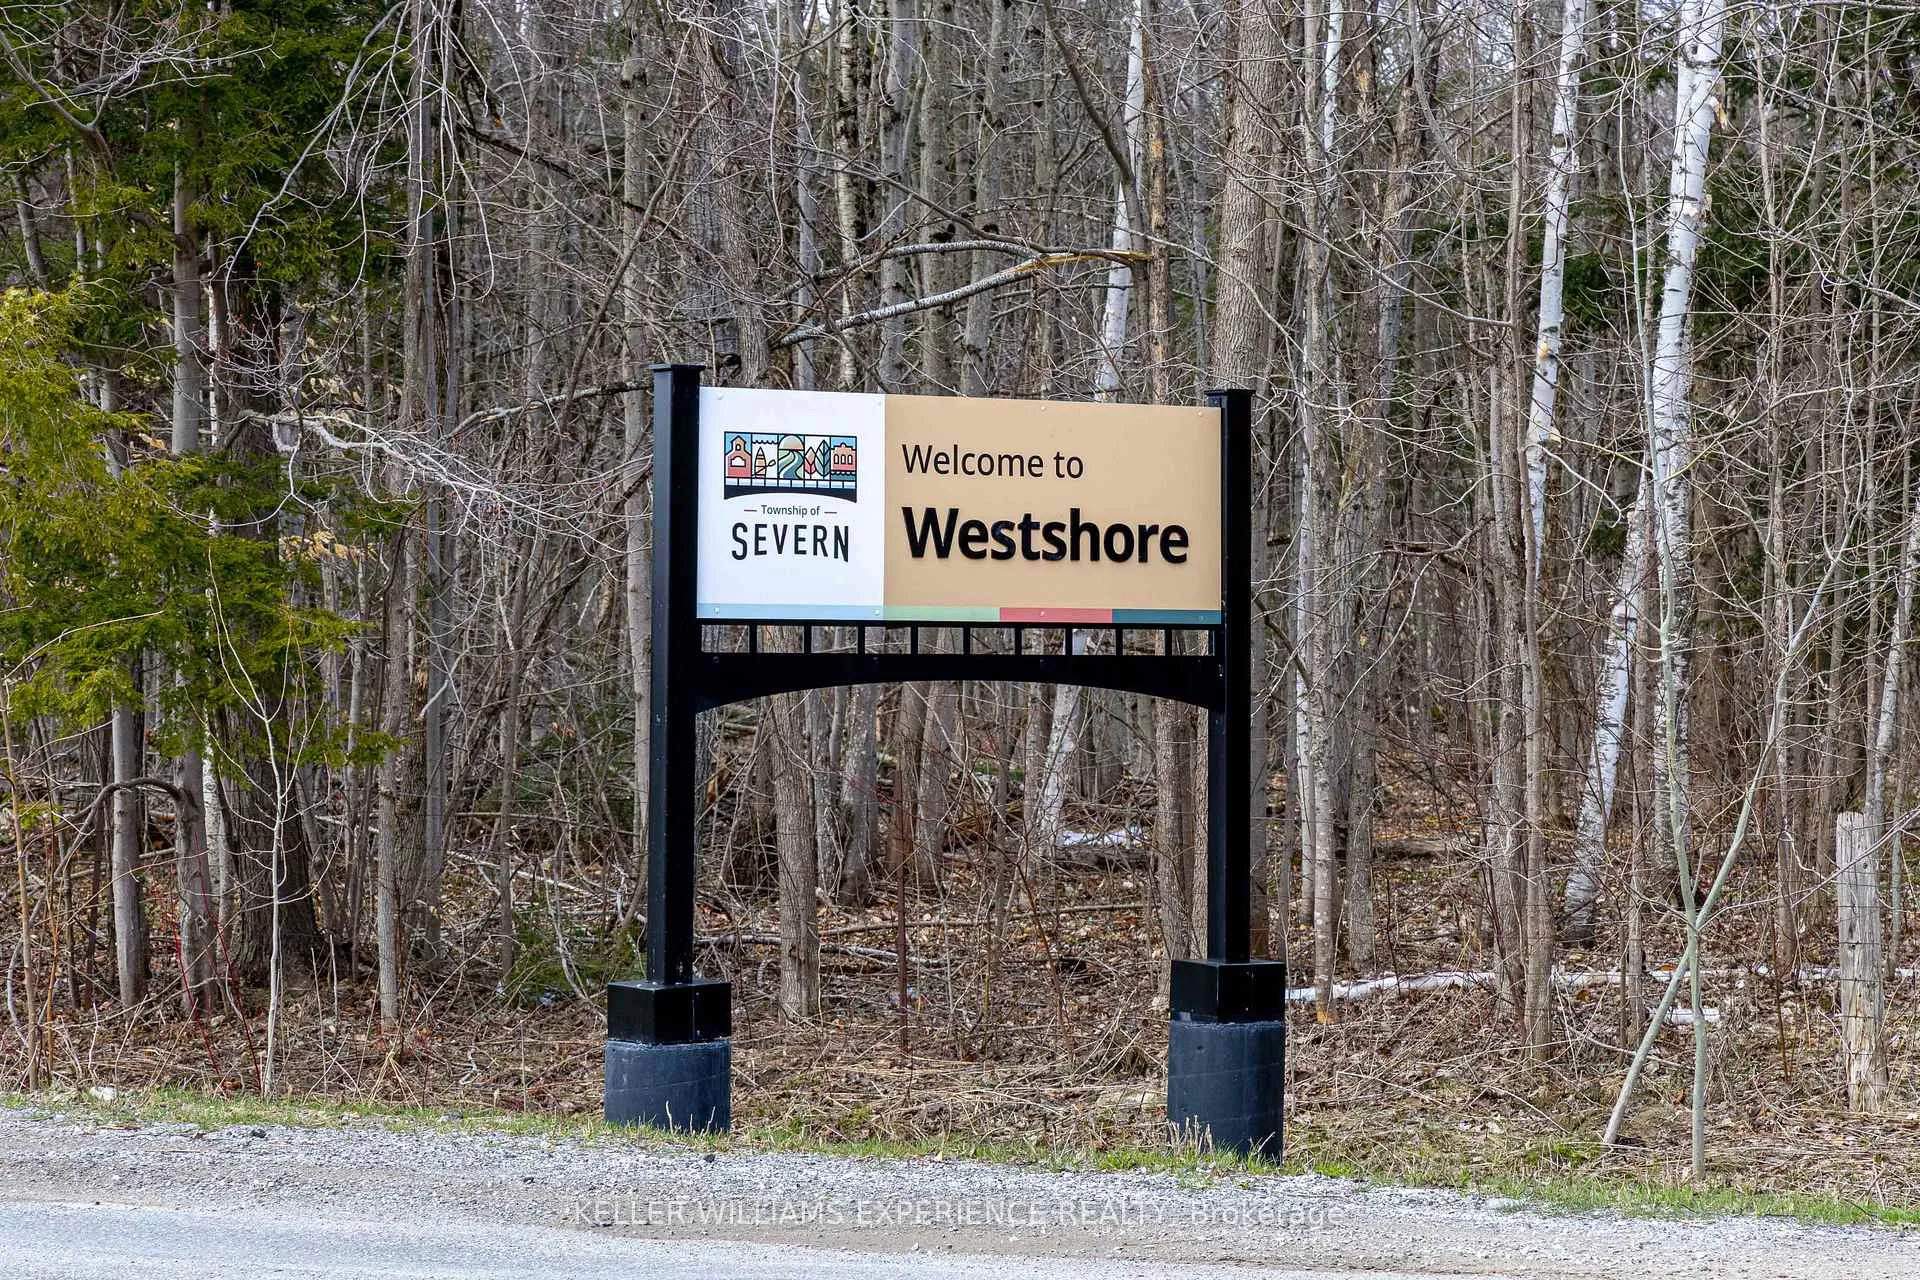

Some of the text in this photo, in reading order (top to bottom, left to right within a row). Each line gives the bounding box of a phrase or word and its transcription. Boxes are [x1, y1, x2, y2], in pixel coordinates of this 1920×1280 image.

[901, 443, 1084, 479] Welcome to
[761, 504, 821, 518] Township of
[731, 522, 849, 563] SEVERN
[901, 506, 1189, 564] Westshore
